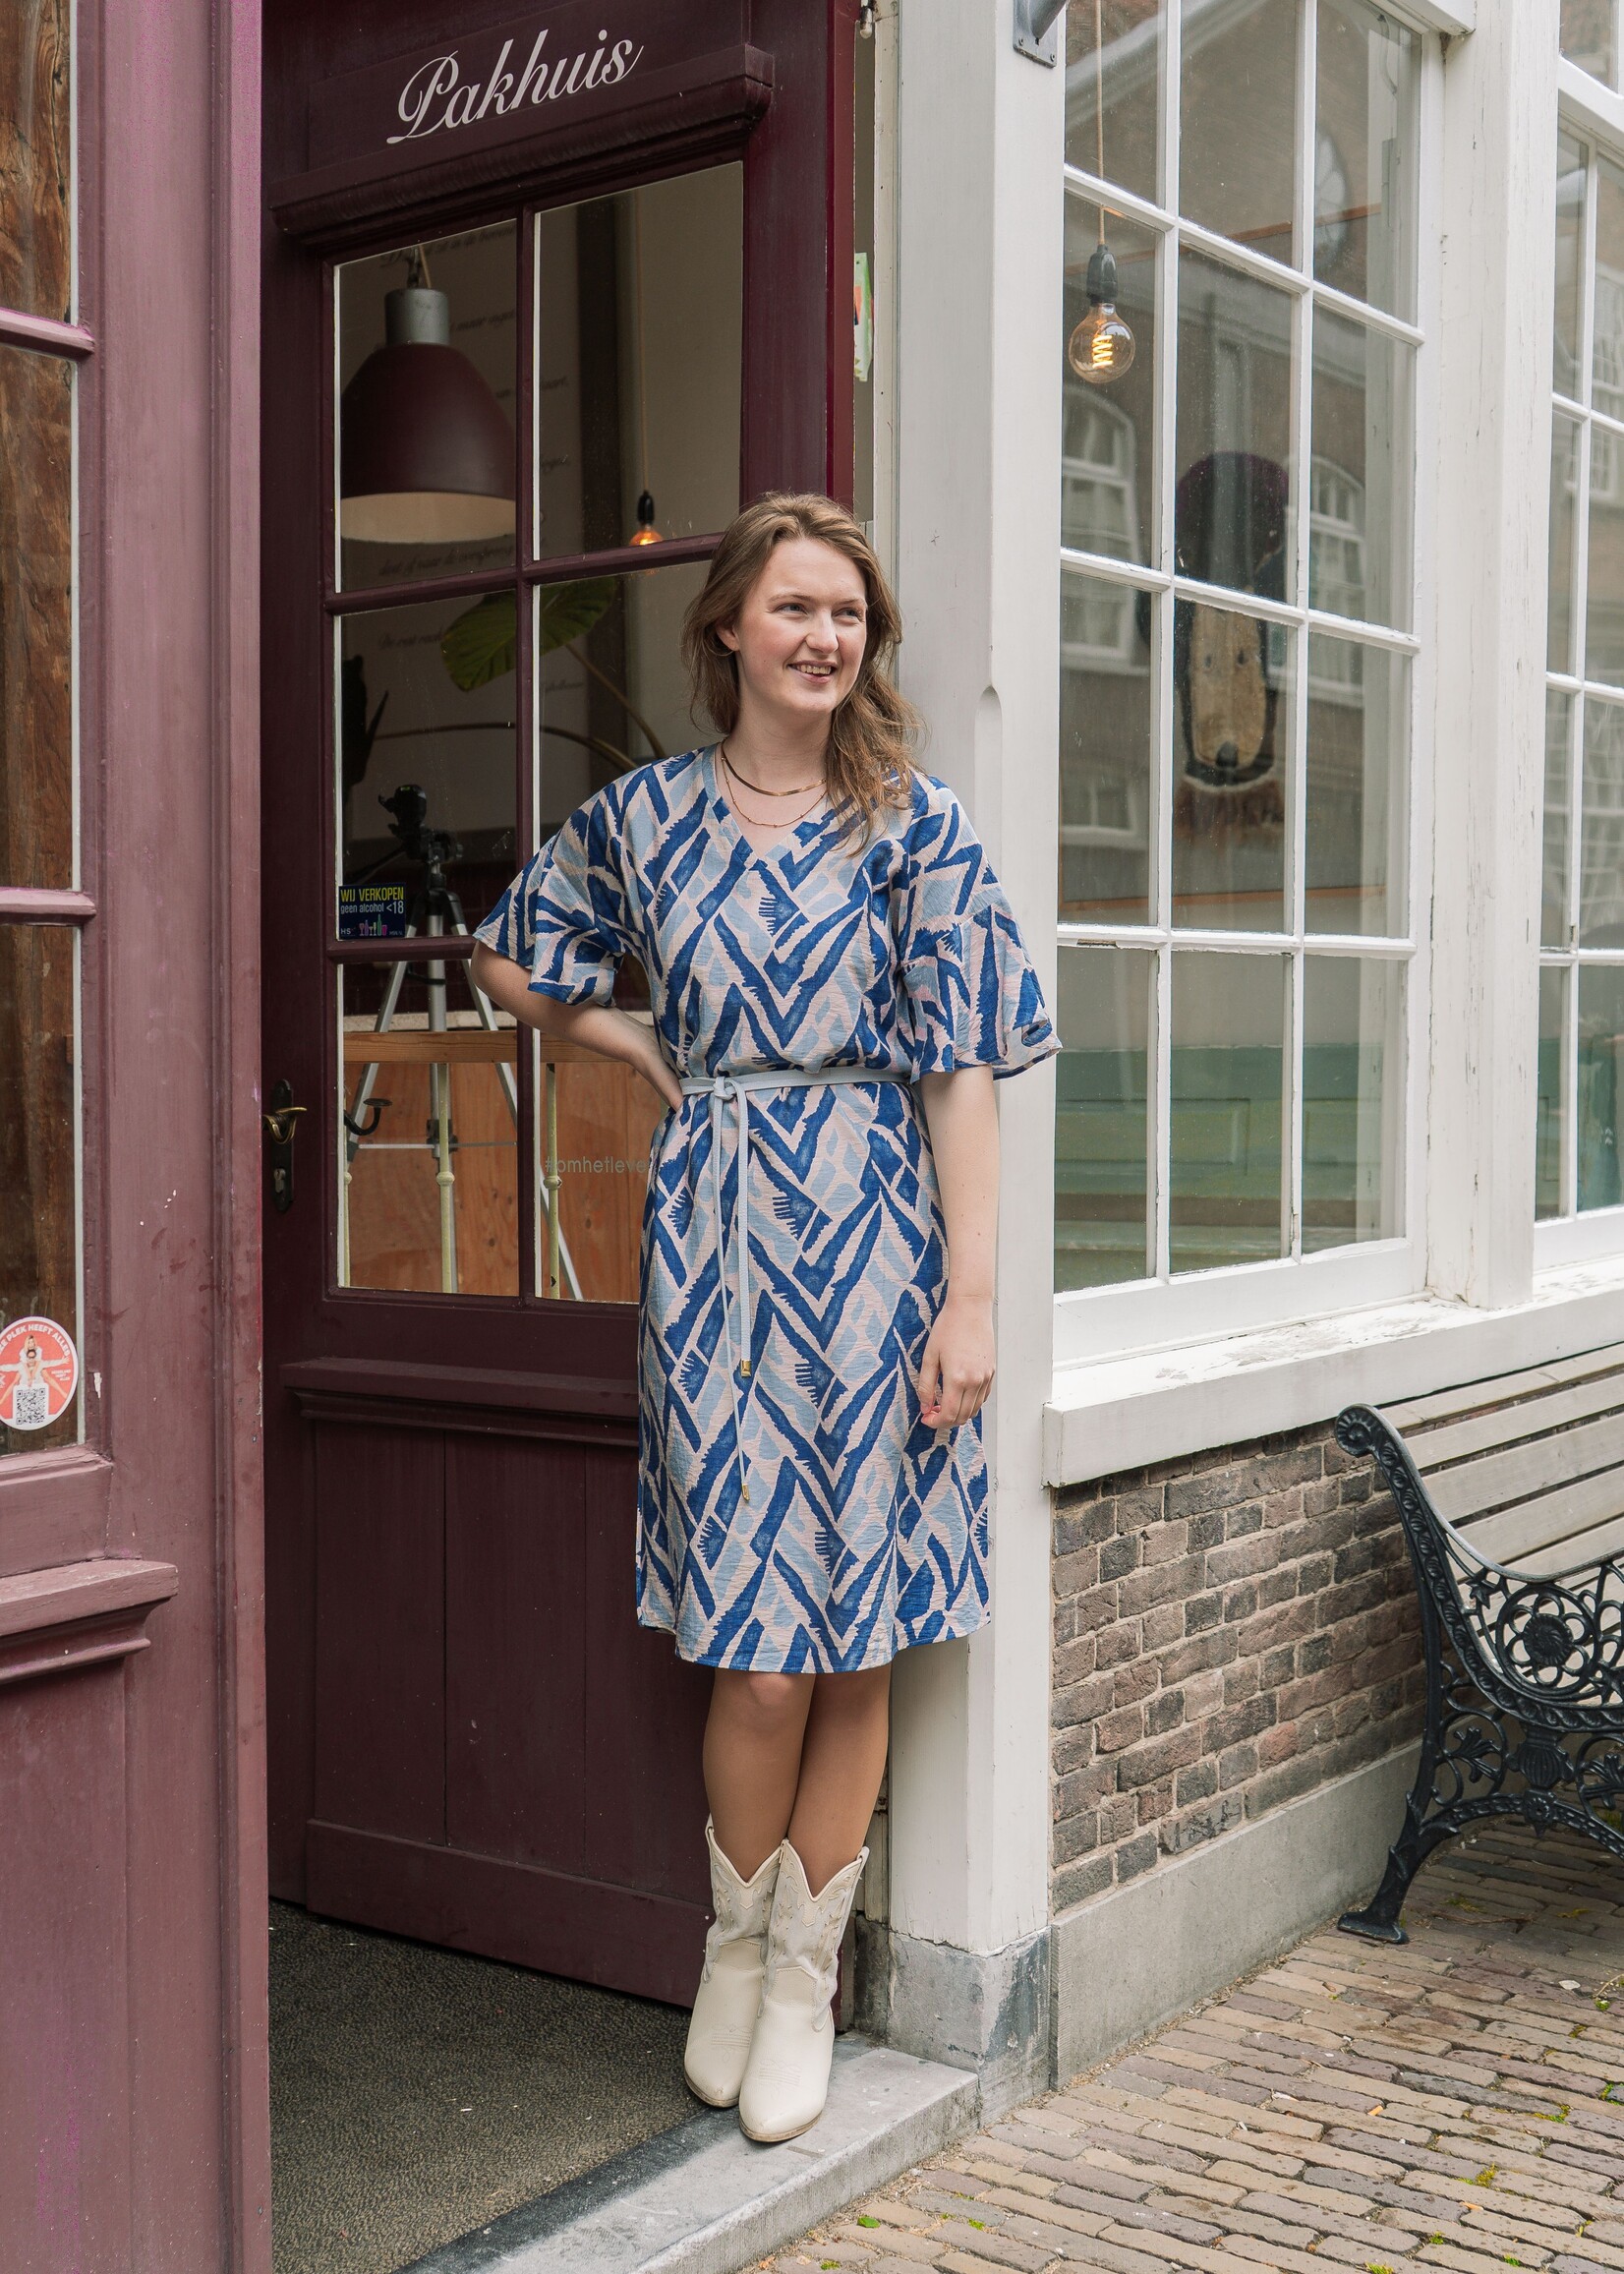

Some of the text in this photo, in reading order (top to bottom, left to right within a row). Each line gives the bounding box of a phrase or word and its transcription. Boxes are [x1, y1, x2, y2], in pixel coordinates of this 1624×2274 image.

[386, 29, 644, 145] Pakhuis
[340, 887, 404, 903] WIJ VERKOPEN
[340, 901, 404, 914] geen alcohol <18
[545, 1155, 648, 1173] #omhetleve
[6, 1325, 27, 1341] PLEK
[28, 1323, 53, 1335] HEEFT
